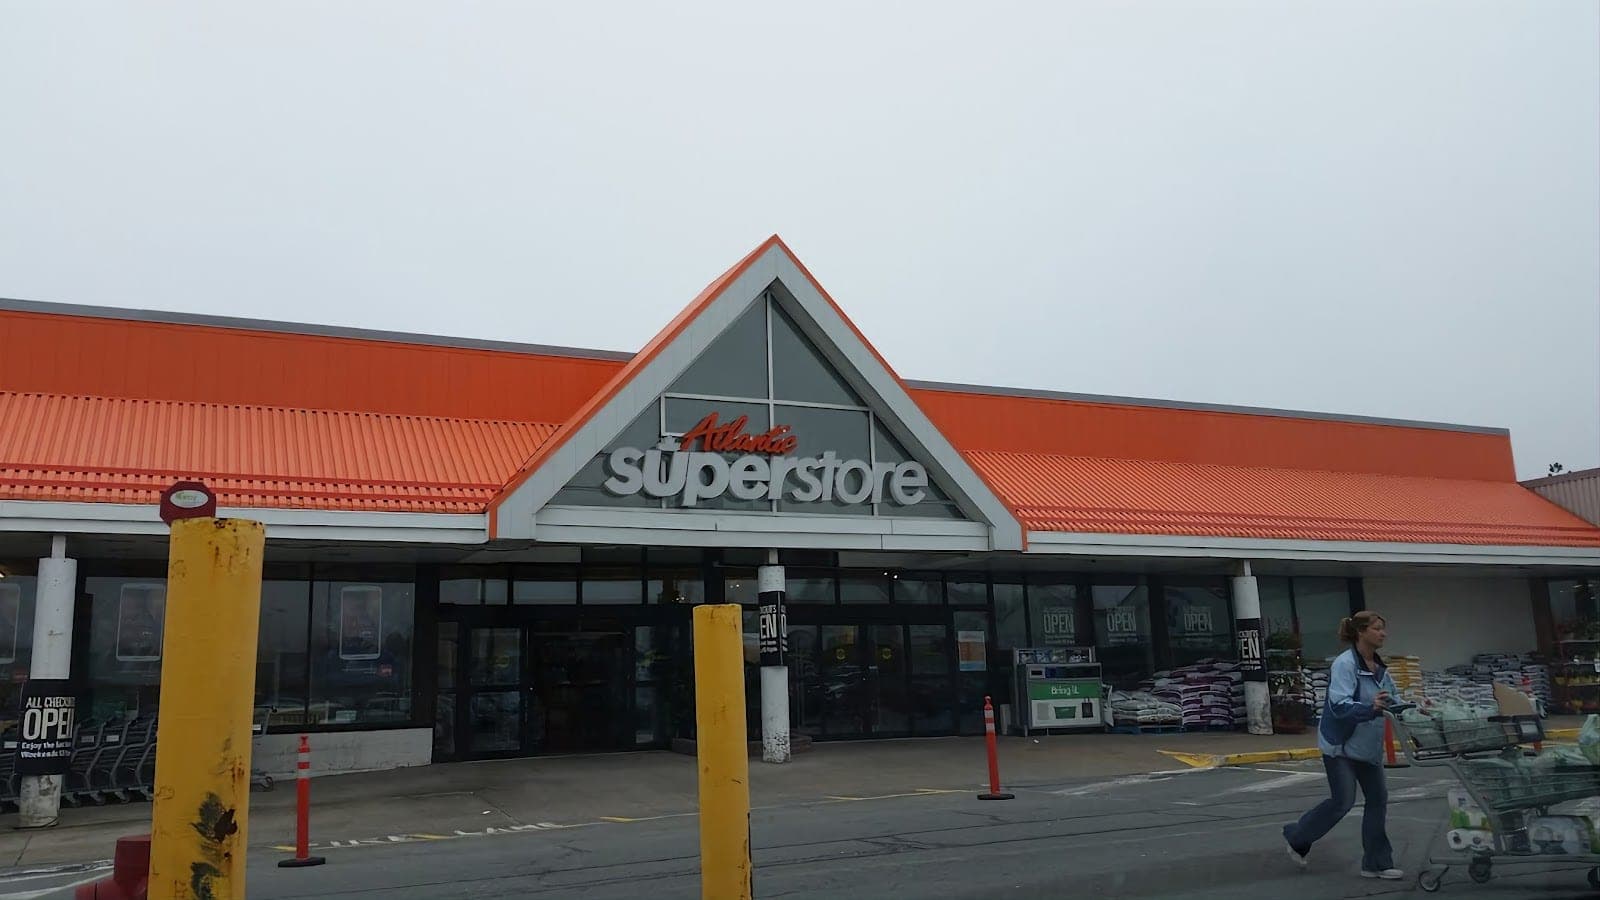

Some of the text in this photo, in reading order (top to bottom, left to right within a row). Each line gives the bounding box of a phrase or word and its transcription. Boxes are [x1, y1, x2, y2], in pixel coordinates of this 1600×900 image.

[681, 411, 798, 455] Atlantic
[604, 447, 928, 506] superstore
[1043, 613, 1075, 633] OPEN
[1106, 611, 1137, 632] OPEN
[1184, 613, 1213, 631] OPEN
[26, 696, 43, 708] ALL
